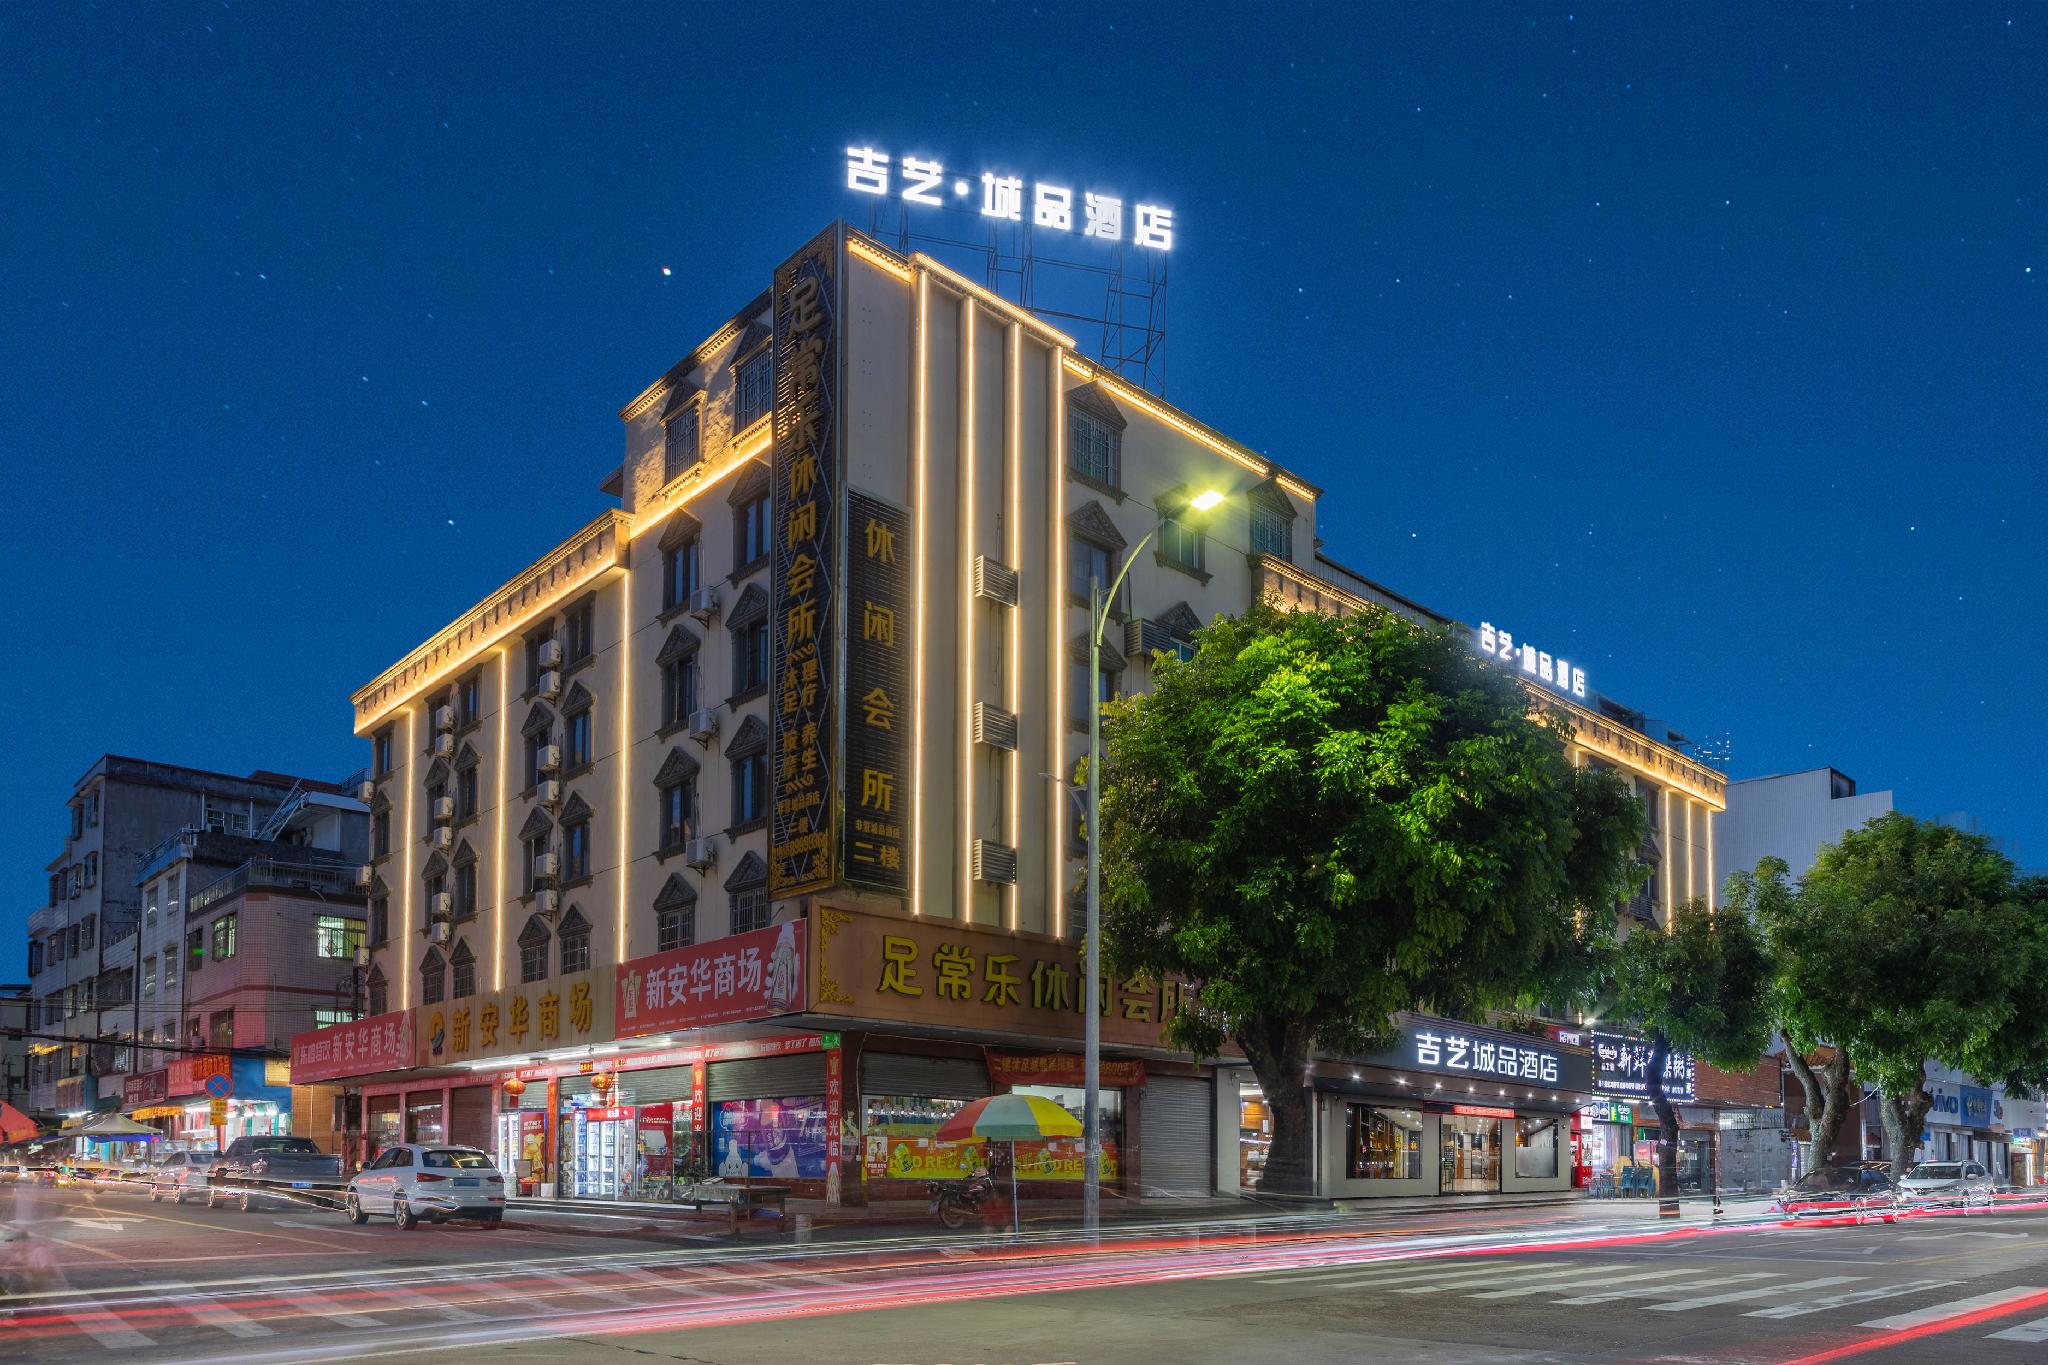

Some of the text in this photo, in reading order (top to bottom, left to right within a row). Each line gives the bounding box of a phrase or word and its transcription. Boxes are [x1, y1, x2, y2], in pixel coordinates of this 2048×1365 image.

[847, 147, 1173, 251] 吉艺·城品酒店
[785, 276, 824, 648] 足常乐休闲会所
[853, 841, 902, 871] 二楼
[645, 946, 763, 1011] 新安华商场
[333, 1022, 396, 1063] 新安华商场
[452, 981, 594, 1053] 新安华商场
[1415, 1033, 1559, 1082] 吉艺城品酒店
[829, 1078, 839, 1157] 欢迎光临
